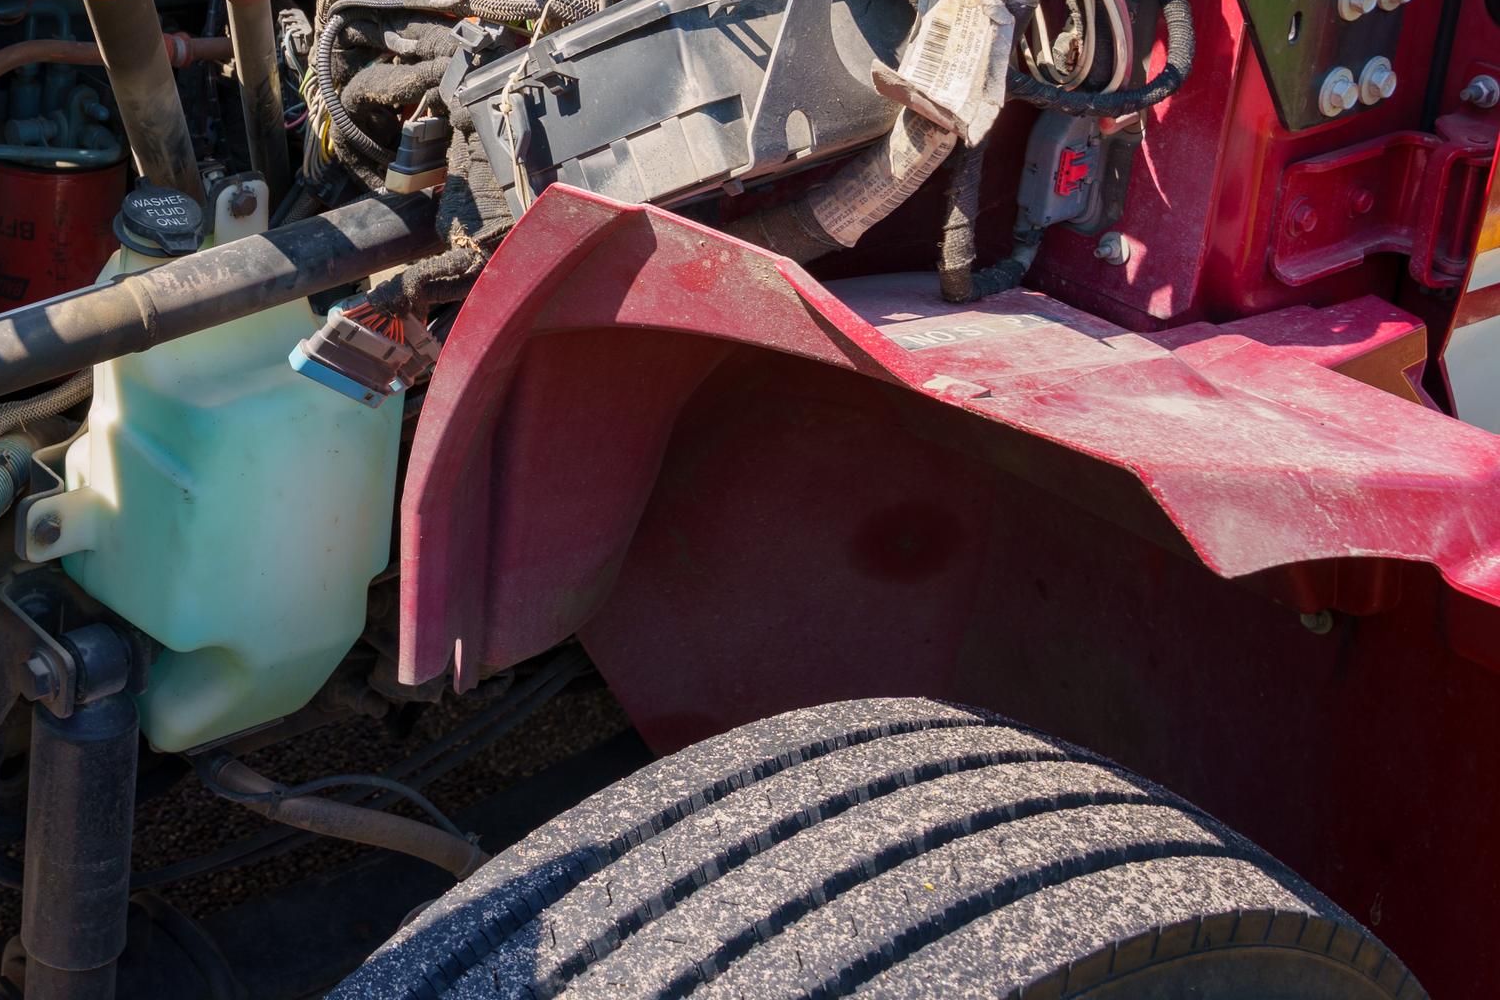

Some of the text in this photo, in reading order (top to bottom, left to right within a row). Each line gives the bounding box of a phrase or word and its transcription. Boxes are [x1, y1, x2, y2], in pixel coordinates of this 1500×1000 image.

[147, 207, 186, 218] FLUID
[156, 217, 189, 227] ONLY
[903, 330, 956, 347] NO
